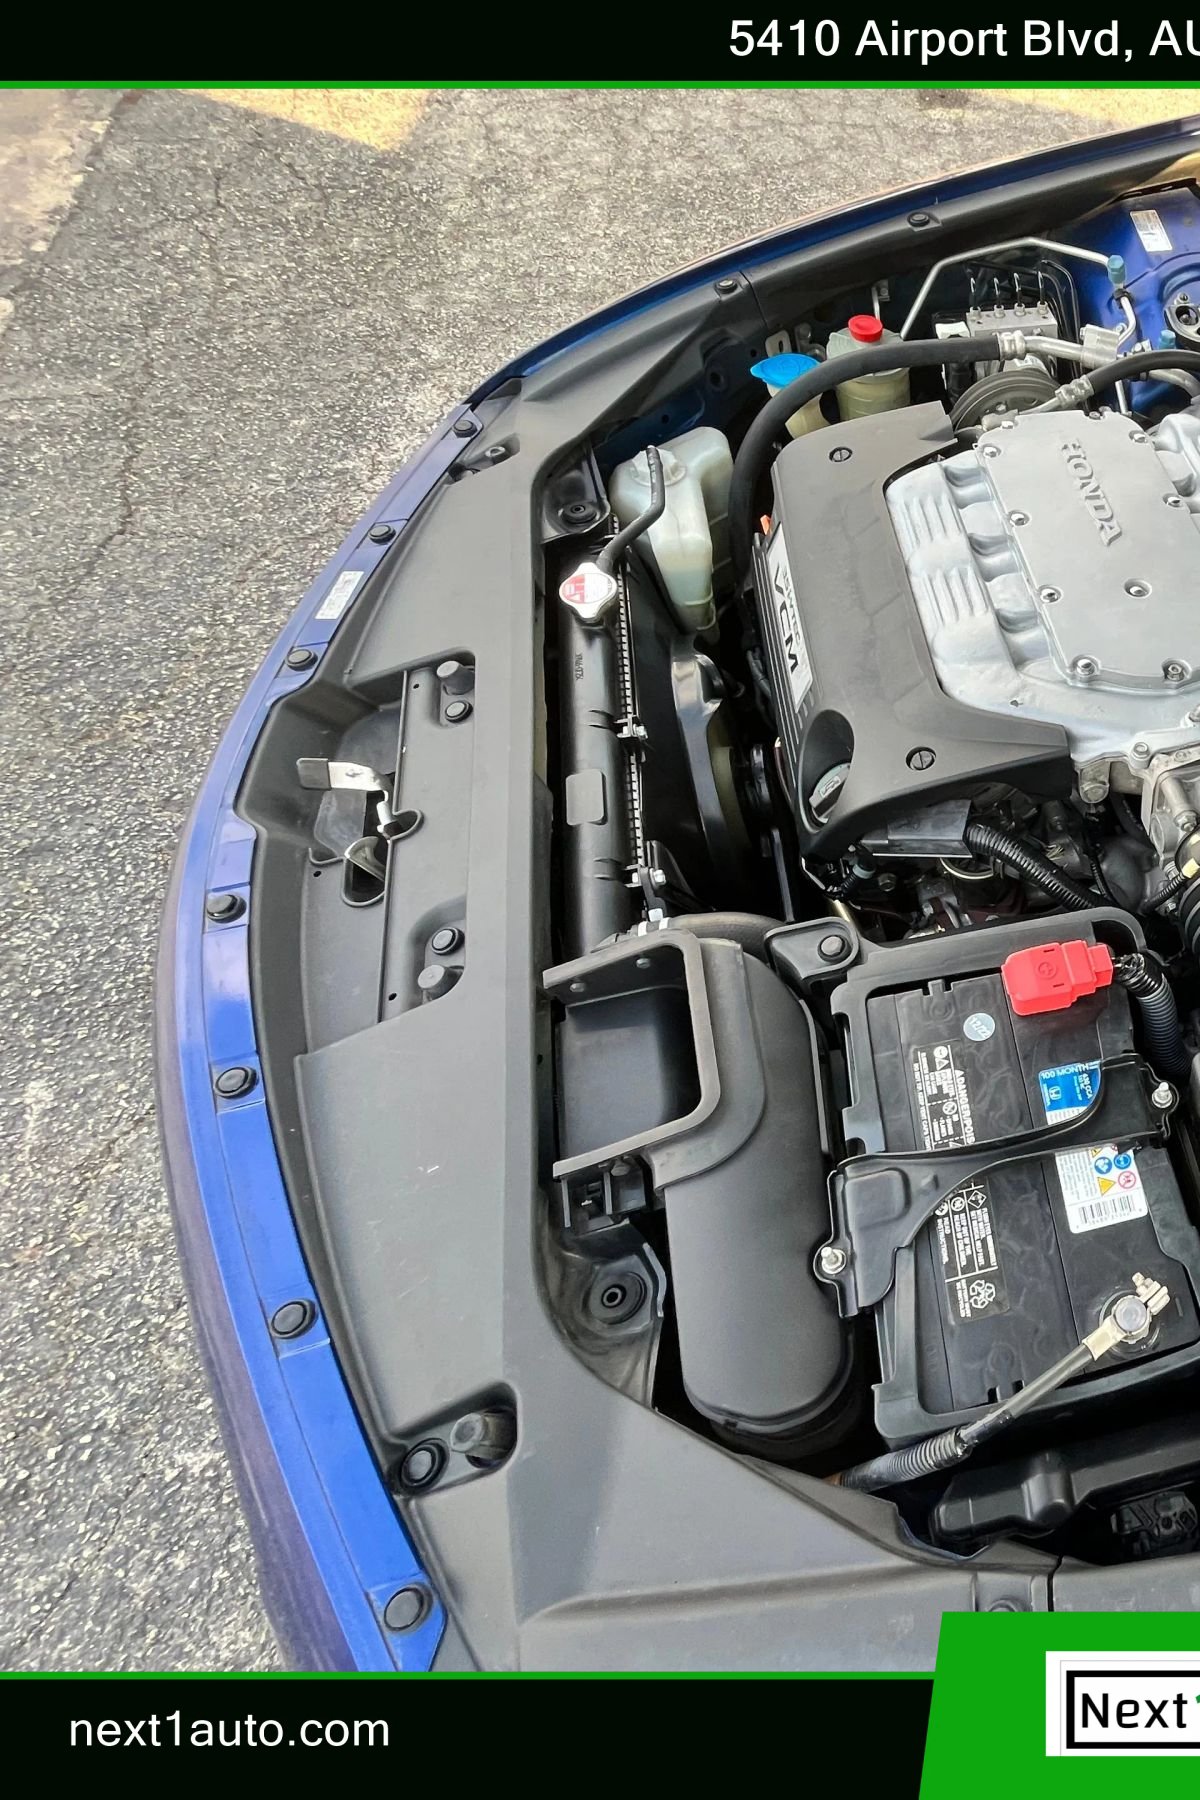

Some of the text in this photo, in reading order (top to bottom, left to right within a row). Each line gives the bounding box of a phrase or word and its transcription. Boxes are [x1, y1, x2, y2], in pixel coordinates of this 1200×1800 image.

[1060, 438, 1122, 547] HONDA
[774, 561, 799, 674] VCM
[1056, 1064, 1089, 1076] MONTH
